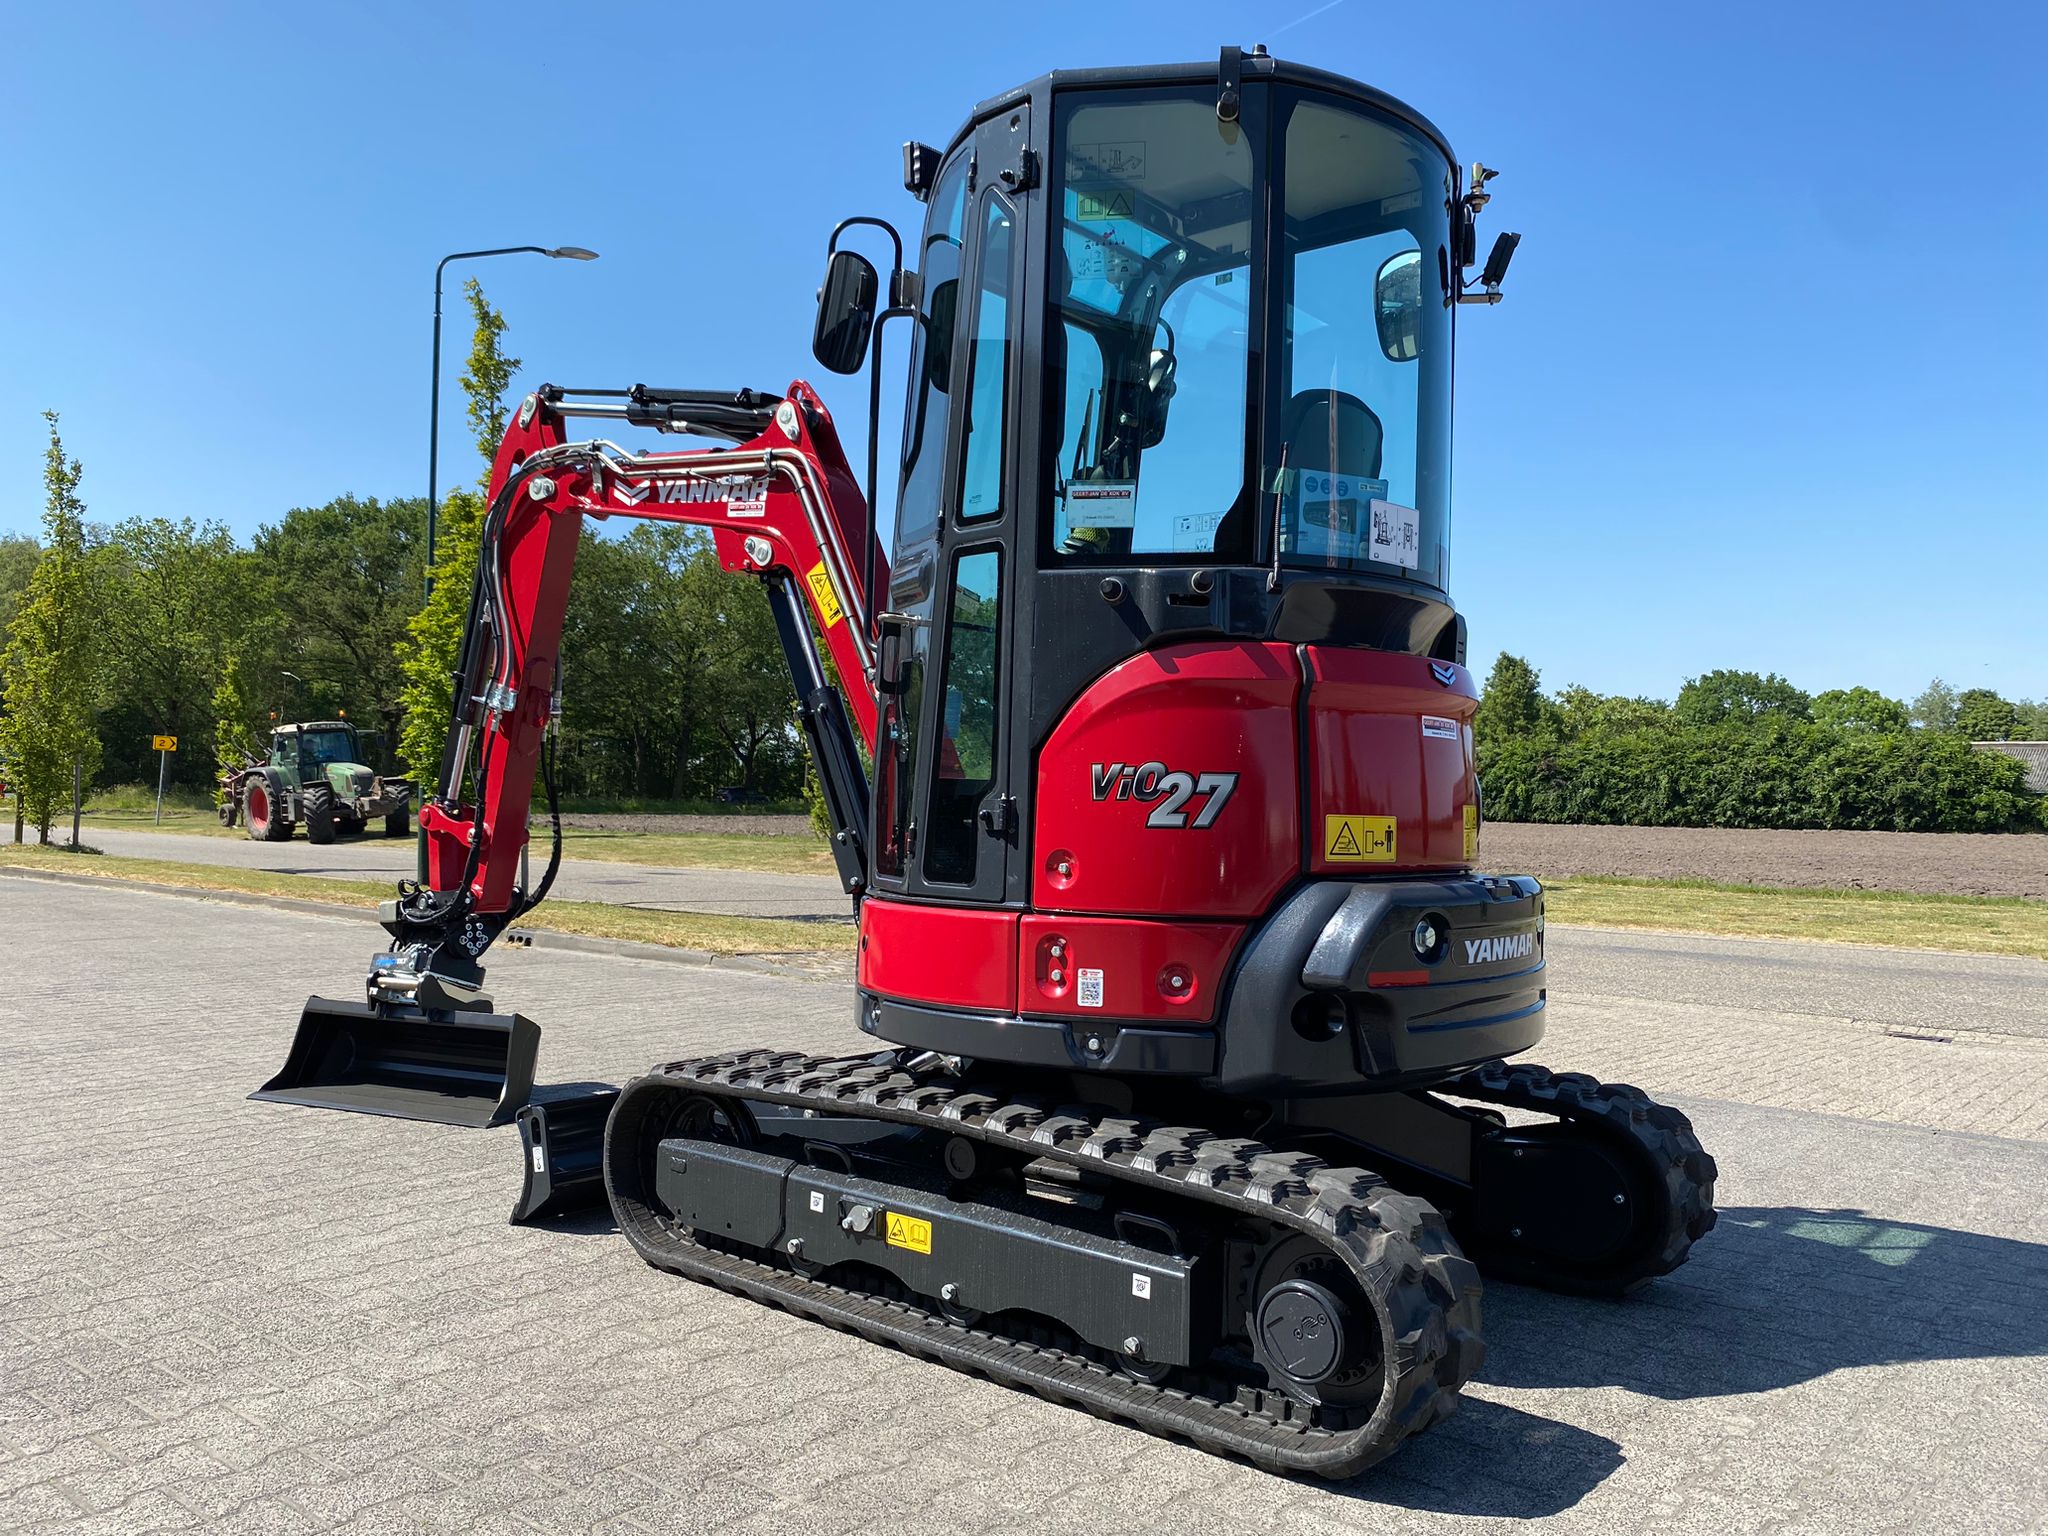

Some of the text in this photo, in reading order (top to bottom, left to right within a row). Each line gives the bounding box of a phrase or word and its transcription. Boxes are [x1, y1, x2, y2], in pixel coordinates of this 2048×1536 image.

[656, 477, 769, 503] YANMAR
[159, 739, 166, 747] 2
[1464, 933, 1533, 964] YANMAR
